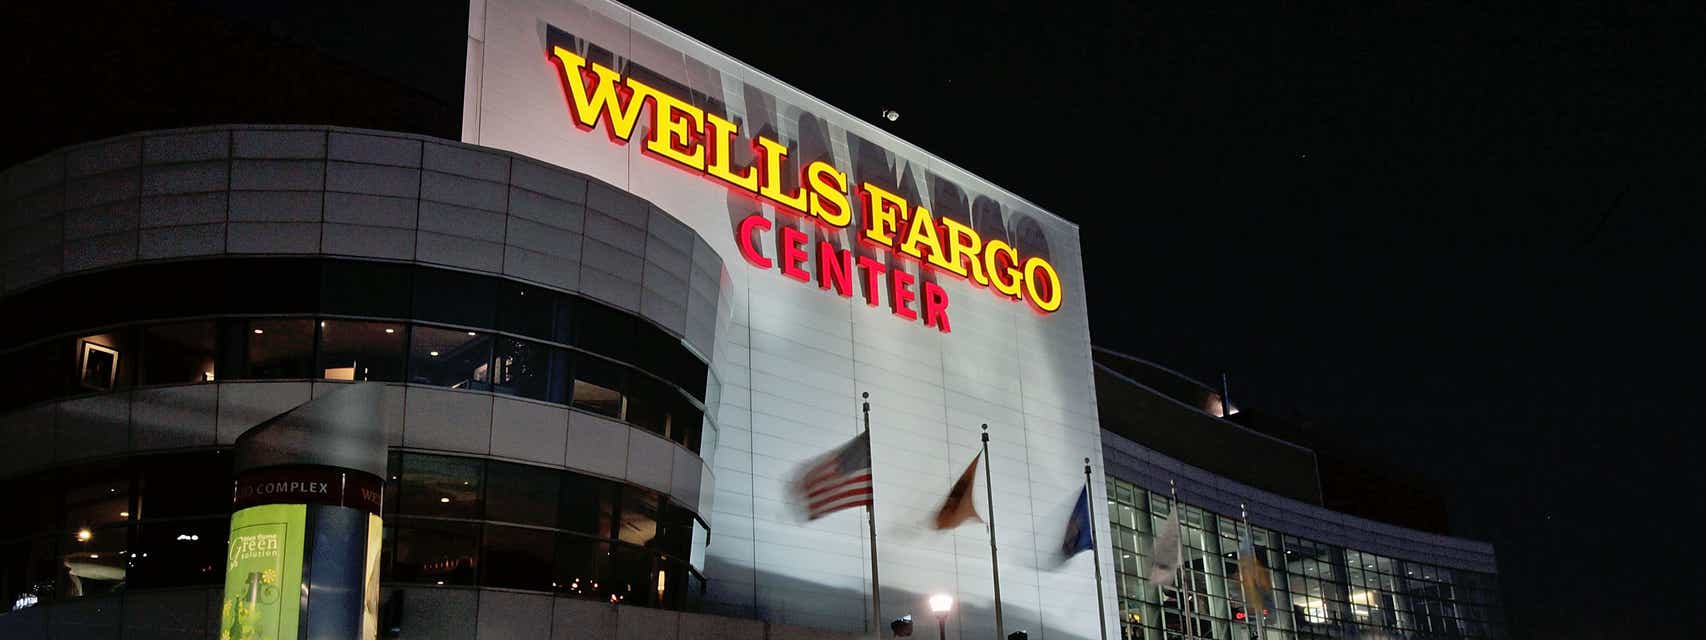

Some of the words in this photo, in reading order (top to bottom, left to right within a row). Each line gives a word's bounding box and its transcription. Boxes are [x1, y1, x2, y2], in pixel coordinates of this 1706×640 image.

[552, 45, 852, 228] WELLS
[862, 182, 1062, 312] FARGO
[738, 214, 951, 334] CENTER
[255, 481, 328, 495] COMPLEX
